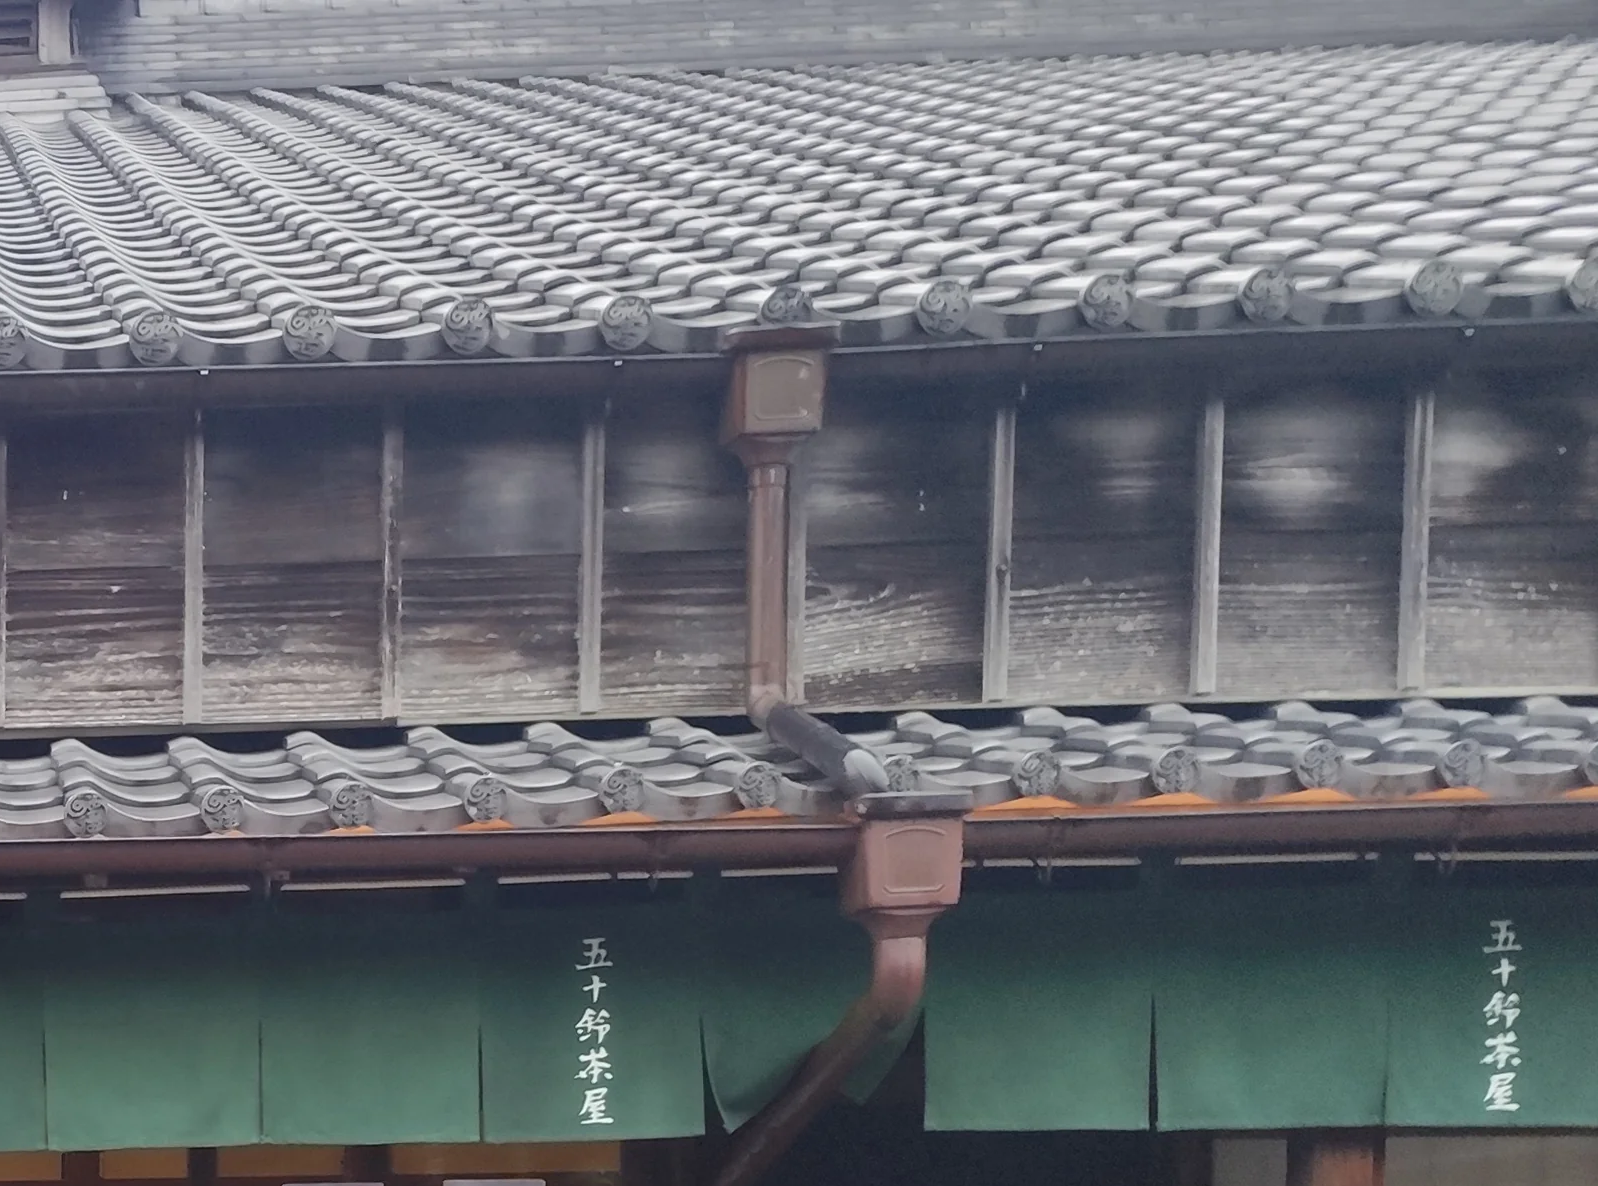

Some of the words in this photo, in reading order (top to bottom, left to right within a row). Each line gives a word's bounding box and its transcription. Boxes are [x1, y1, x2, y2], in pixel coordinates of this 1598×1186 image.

[574, 937, 614, 1125] 五十鈴茶屋
[1479, 919, 1522, 1112] 五十鈴茶屋
